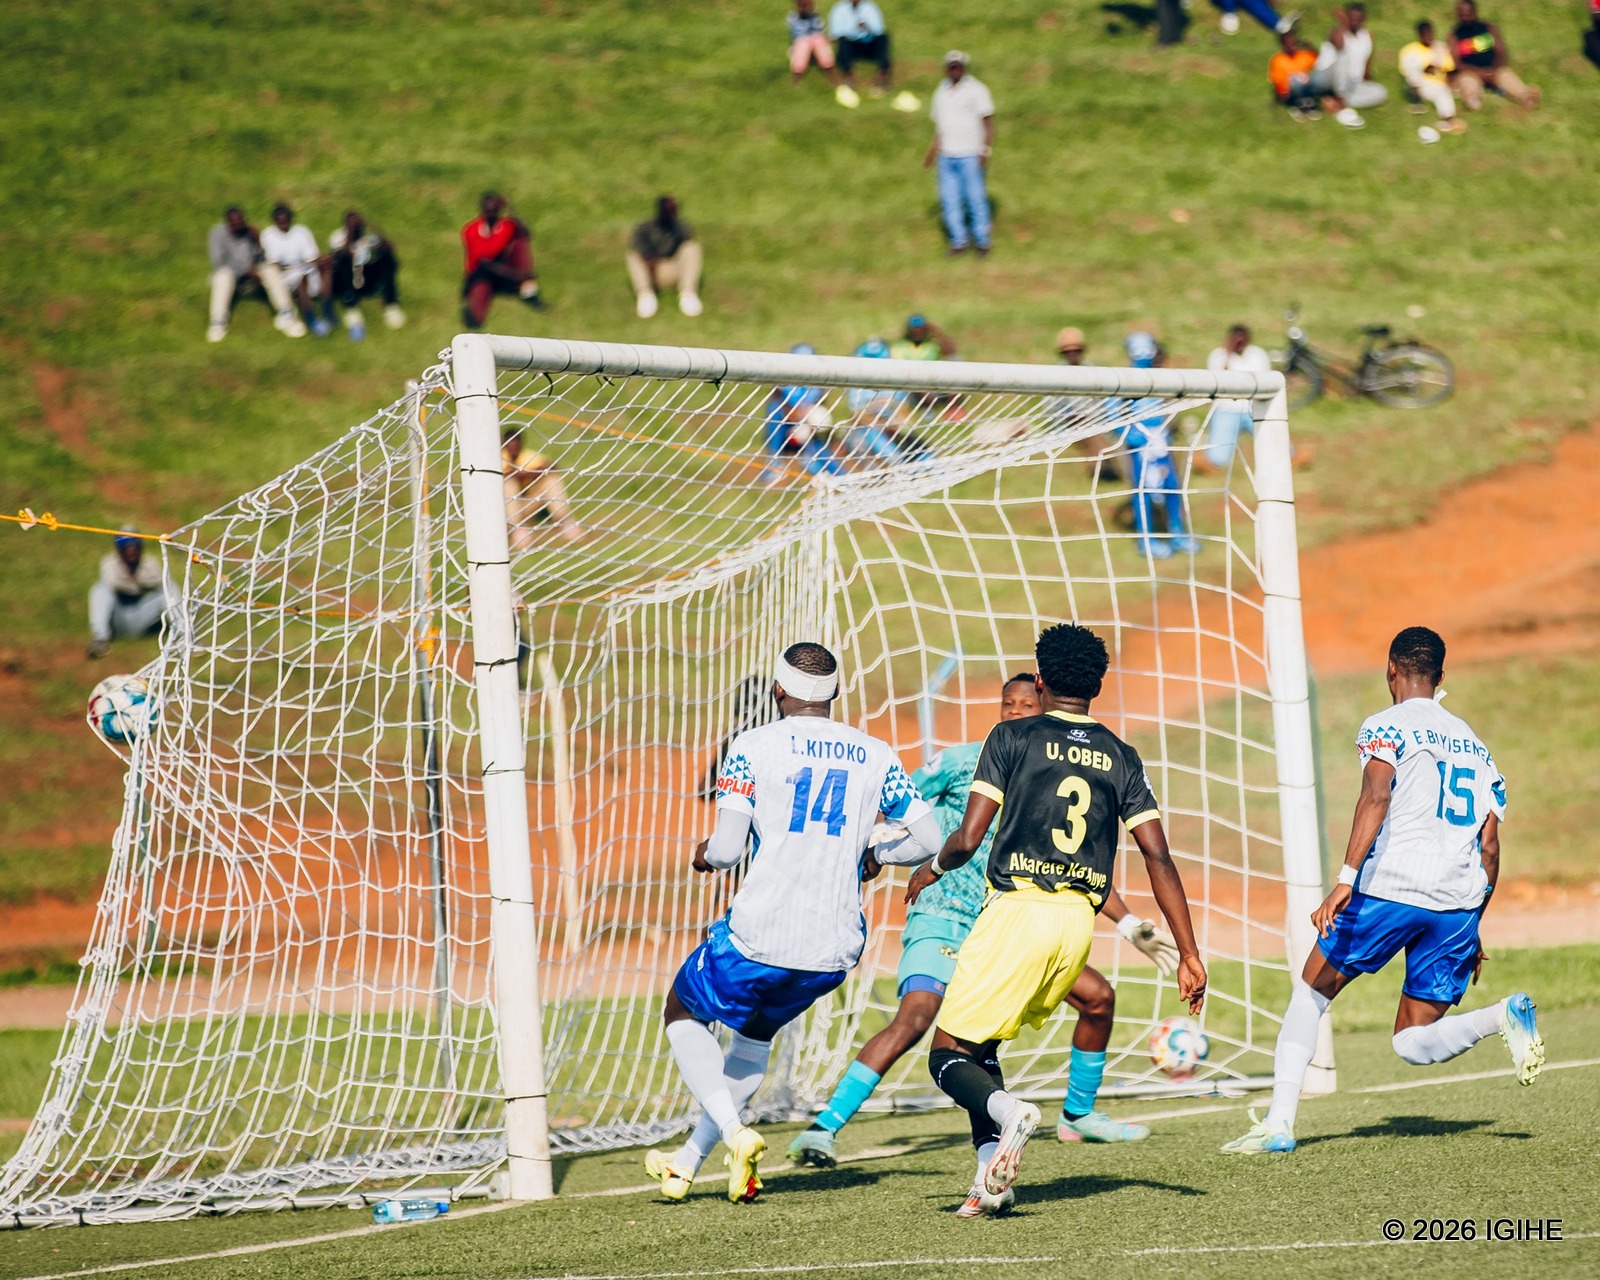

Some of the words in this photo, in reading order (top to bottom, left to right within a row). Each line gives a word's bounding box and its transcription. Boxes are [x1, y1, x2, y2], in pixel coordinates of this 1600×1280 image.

[1046, 742, 1064, 761] U.
[1067, 746, 1113, 772] OBED
[786, 766, 849, 837] 14
[1051, 775, 1092, 855] 3
[1436, 760, 1477, 827] 15
